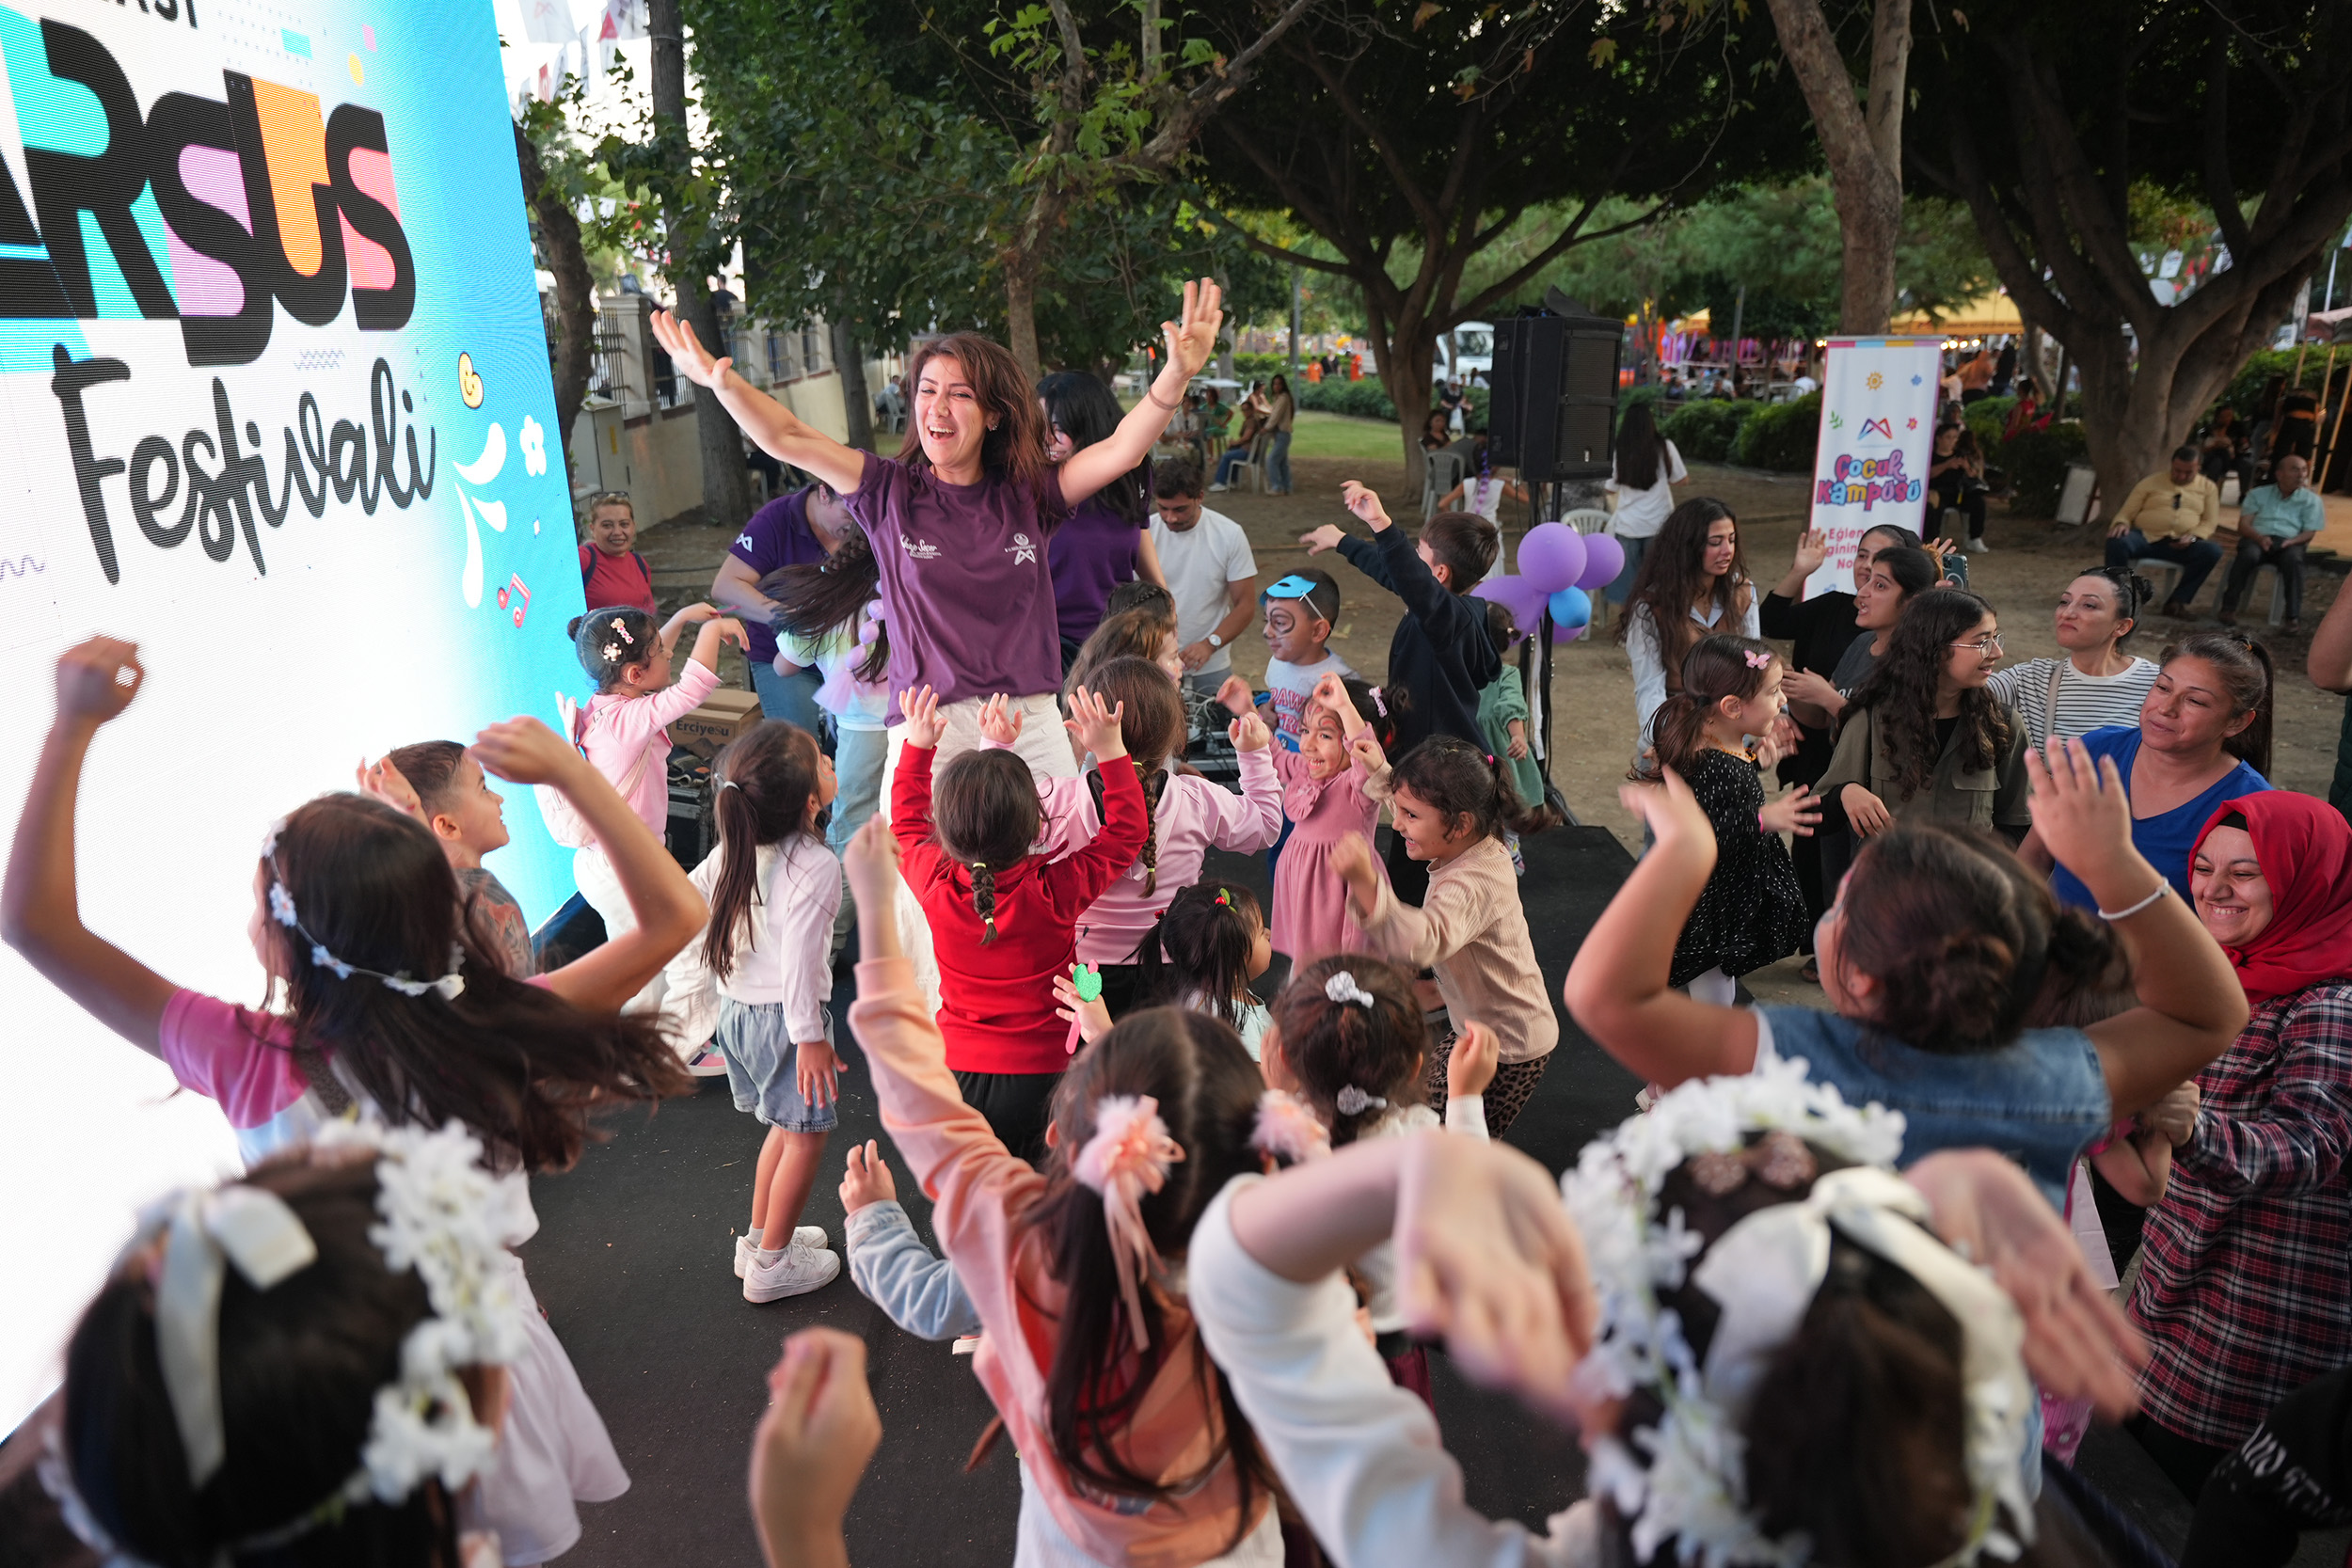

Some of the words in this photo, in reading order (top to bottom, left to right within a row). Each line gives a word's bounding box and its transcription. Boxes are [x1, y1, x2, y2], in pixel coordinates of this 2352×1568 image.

[51, 343, 437, 585] Festivali
[1816, 479, 1921, 511] Kampüsü
[1829, 528, 1865, 542] Eğlen
[1825, 543, 1858, 557] ginin
[1836, 558, 1853, 569] No
[676, 720, 730, 736] ErciyeSu
